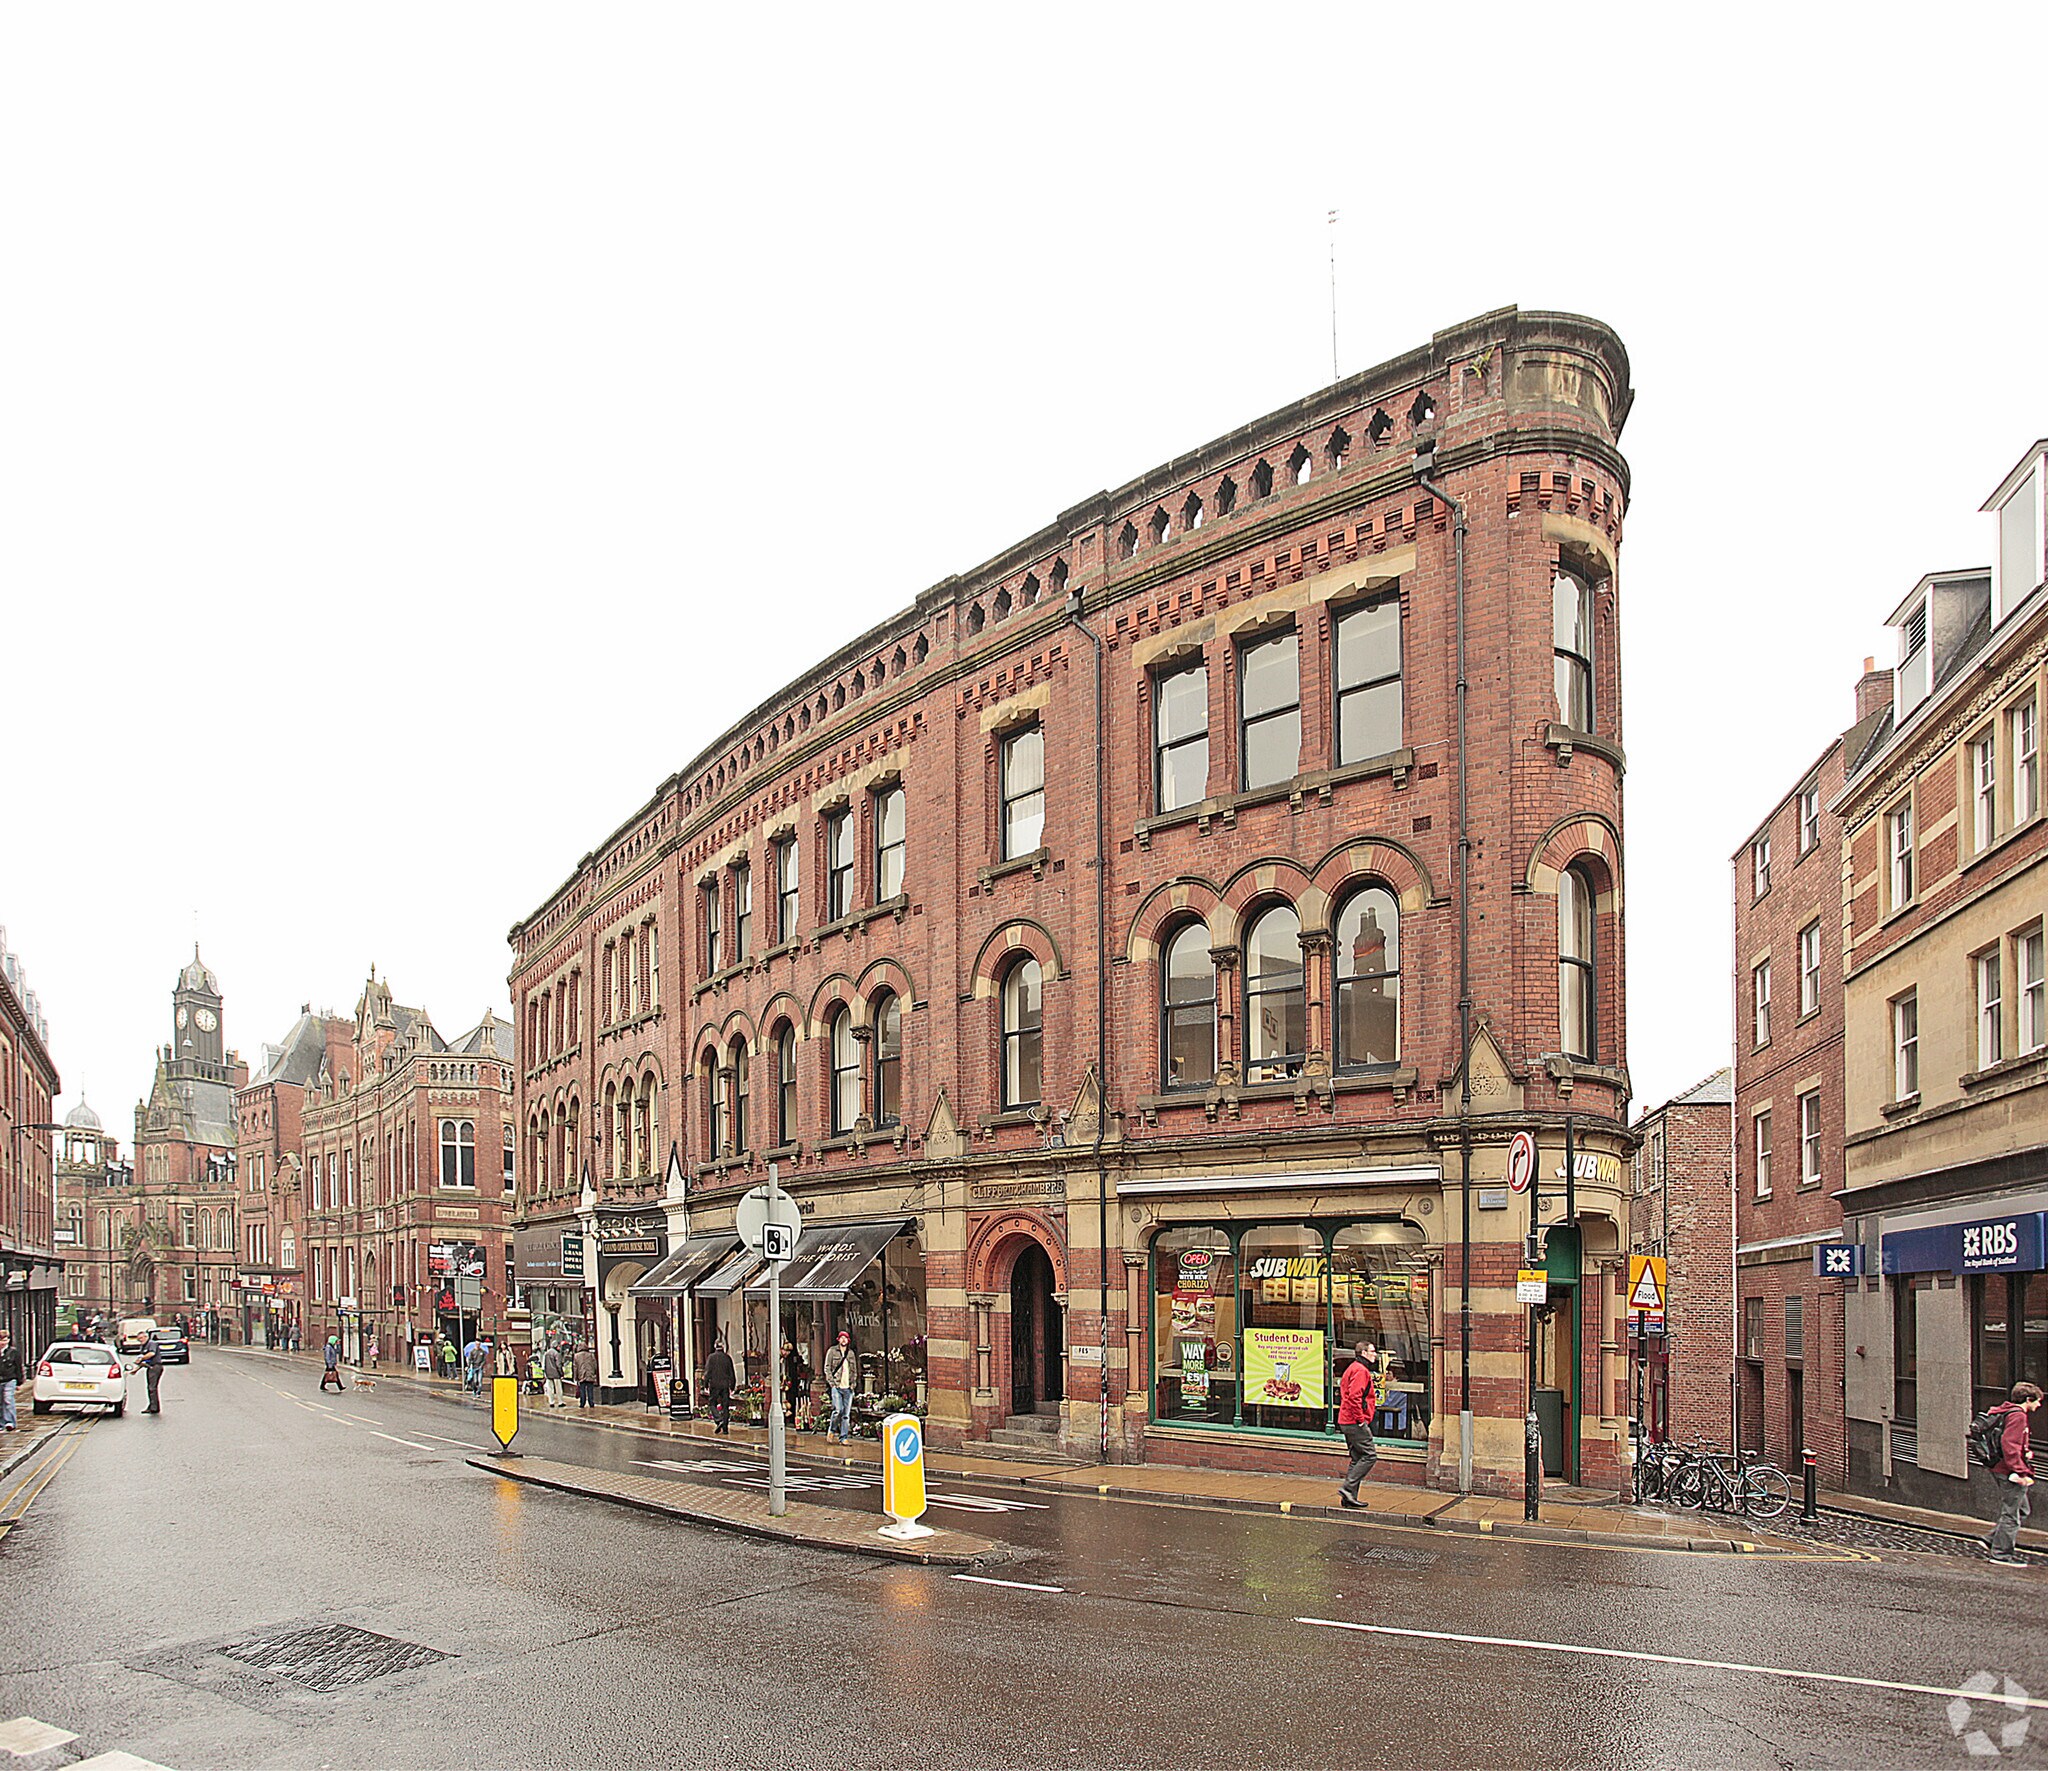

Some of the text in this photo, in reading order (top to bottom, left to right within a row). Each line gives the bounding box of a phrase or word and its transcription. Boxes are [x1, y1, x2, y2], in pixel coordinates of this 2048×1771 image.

[1554, 1152, 1622, 1183] SUBWAY
[1016, 1181, 1064, 1195] CHAMBERS
[1981, 1222, 2018, 1256] RBS
[817, 1243, 856, 1253] WARDS
[795, 1254, 816, 1263] THE
[1183, 1253, 1209, 1265] OPEN
[1249, 1257, 1328, 1279] SUBWAY
[1177, 1280, 1209, 1289] CHORIZO
[1637, 1290, 1656, 1300] Flood
[848, 1311, 881, 1327] Wards
[1254, 1332, 1313, 1344] Student Deal
[1182, 1343, 1206, 1360] WAY
[1183, 1359, 1205, 1371] MORE
[1186, 1372, 1200, 1382] £5
